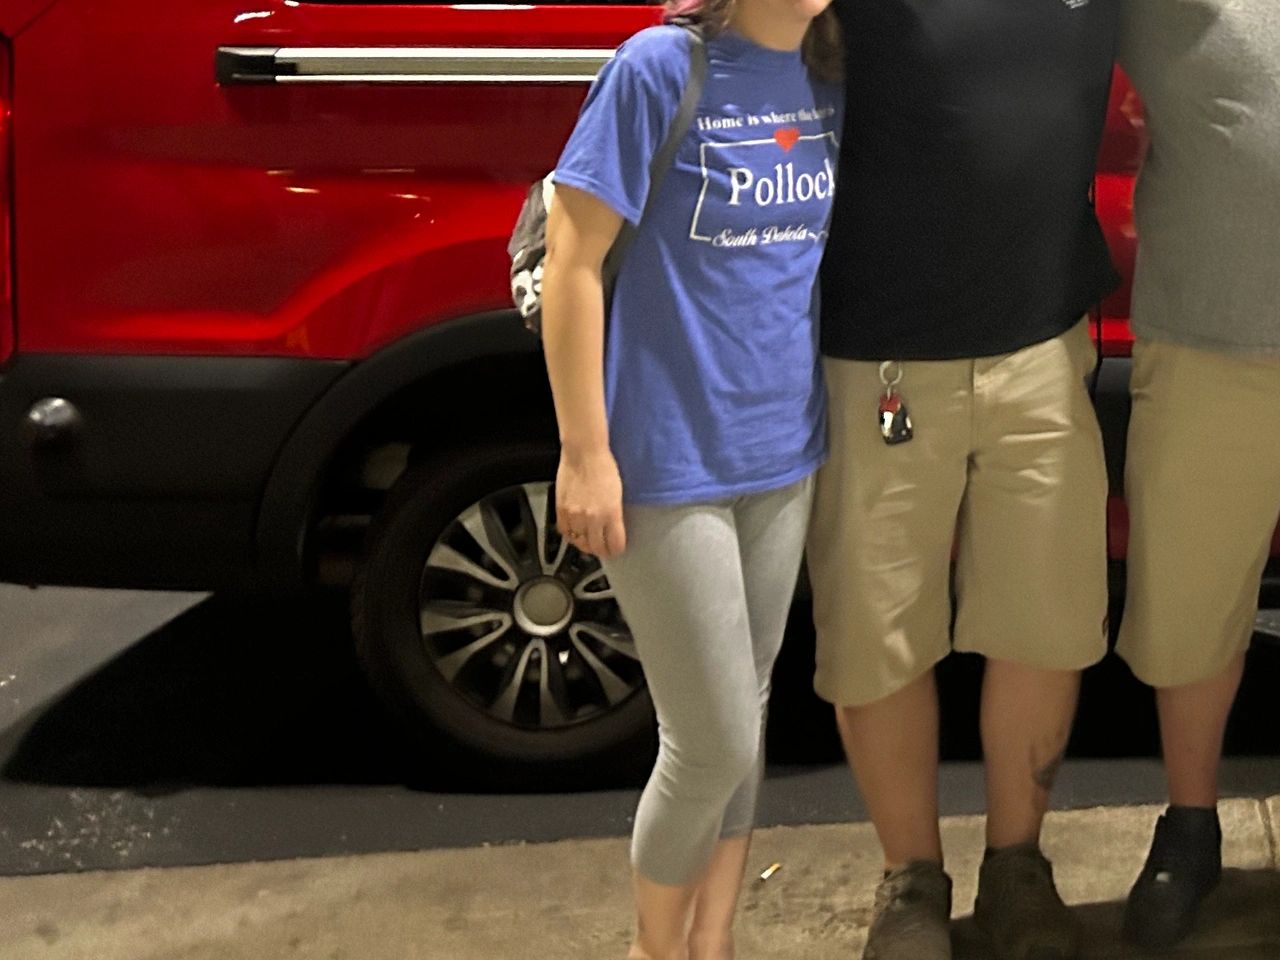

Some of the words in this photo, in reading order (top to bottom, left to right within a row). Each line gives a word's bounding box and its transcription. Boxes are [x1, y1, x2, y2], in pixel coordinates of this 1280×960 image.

[697, 116, 744, 131] Home
[747, 113, 760, 126] is
[761, 110, 797, 124] where
[712, 227, 758, 248] South
[760, 224, 808, 244] Dakota
